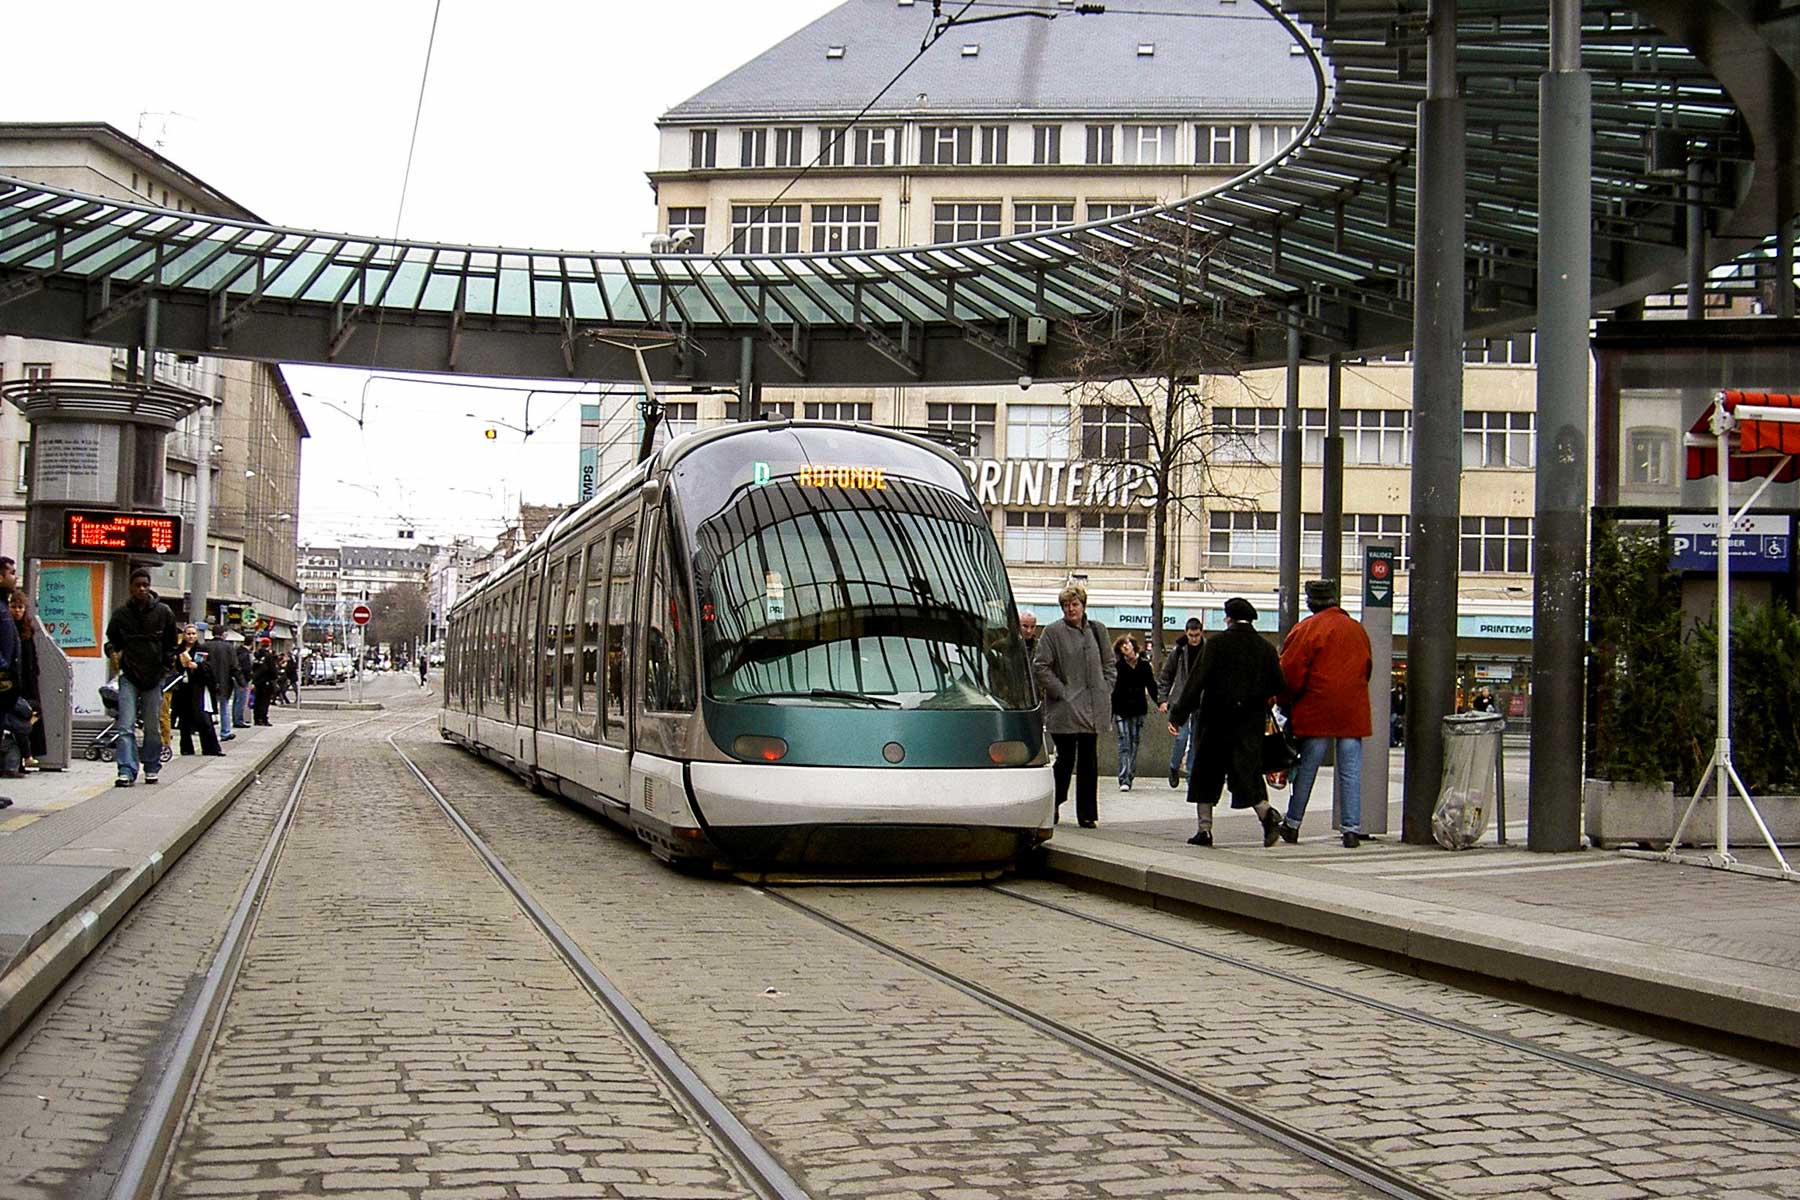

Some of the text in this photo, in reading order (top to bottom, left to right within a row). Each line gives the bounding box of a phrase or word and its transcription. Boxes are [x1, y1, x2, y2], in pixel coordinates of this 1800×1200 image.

[754, 462, 887, 489] D ROTONDE
[963, 459, 1159, 507] PRINTEMPS
[1119, 614, 1176, 624] PRINTEPS
[1480, 624, 1532, 633] PRINTEMP
